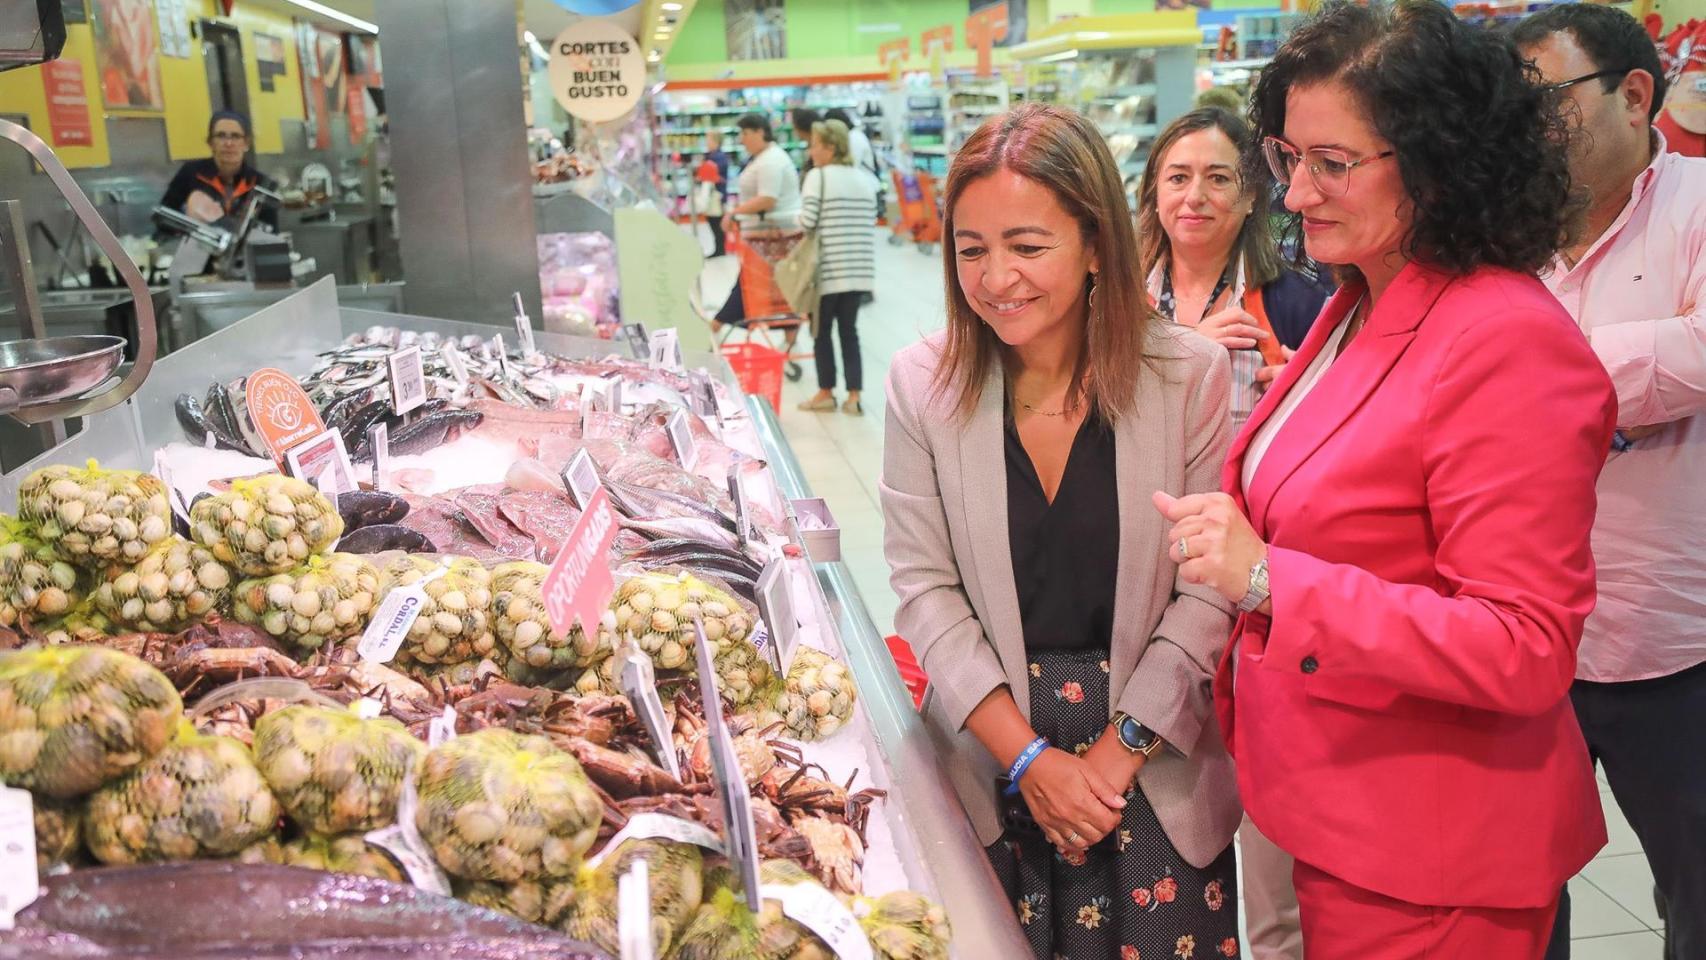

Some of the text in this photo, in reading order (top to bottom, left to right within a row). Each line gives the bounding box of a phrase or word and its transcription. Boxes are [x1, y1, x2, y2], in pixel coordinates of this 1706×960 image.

[560, 41, 630, 56] CORTES
[573, 71, 621, 83] BUEN
[567, 85, 628, 99] GUSTO
